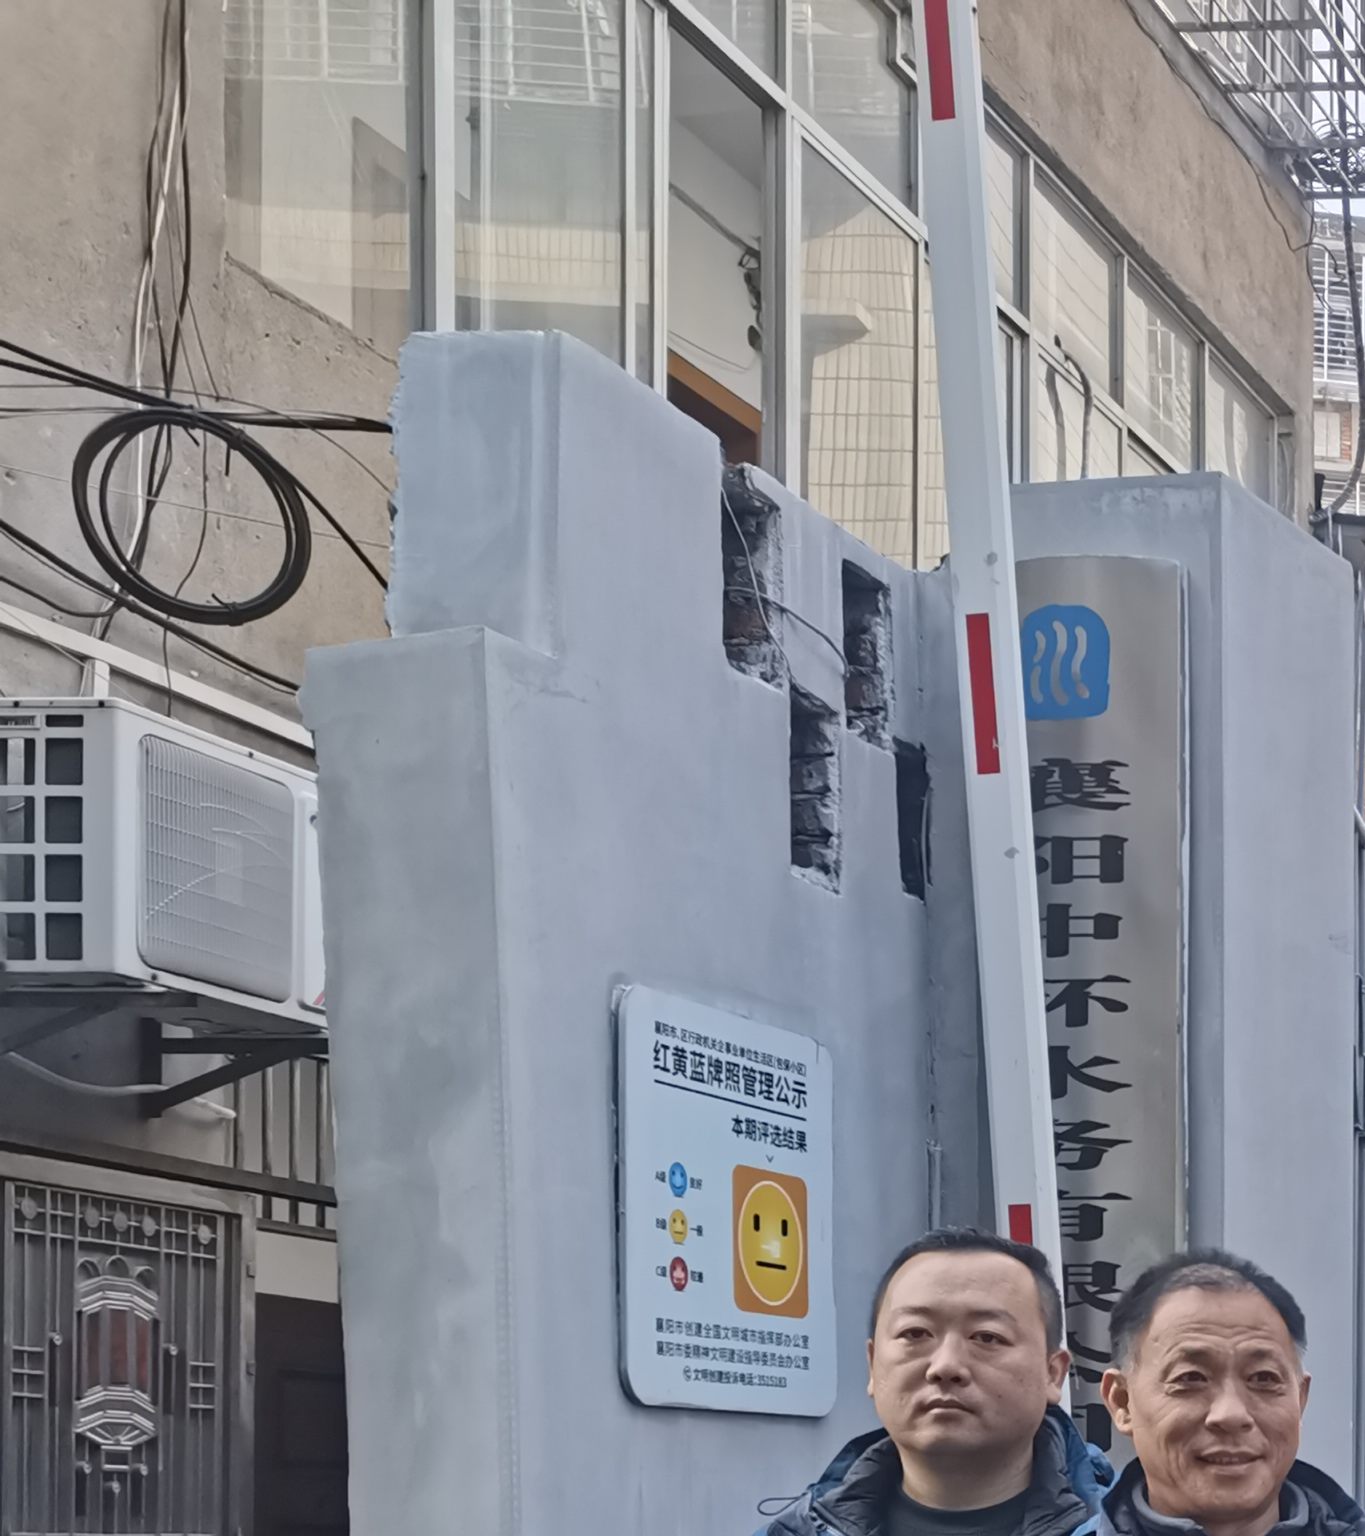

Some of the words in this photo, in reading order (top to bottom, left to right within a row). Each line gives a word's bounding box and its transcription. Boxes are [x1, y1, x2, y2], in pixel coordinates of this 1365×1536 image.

[652, 1039, 808, 1110] 红黄蓝牌照管理公示
[731, 1114, 808, 1153] 本期评选结果
